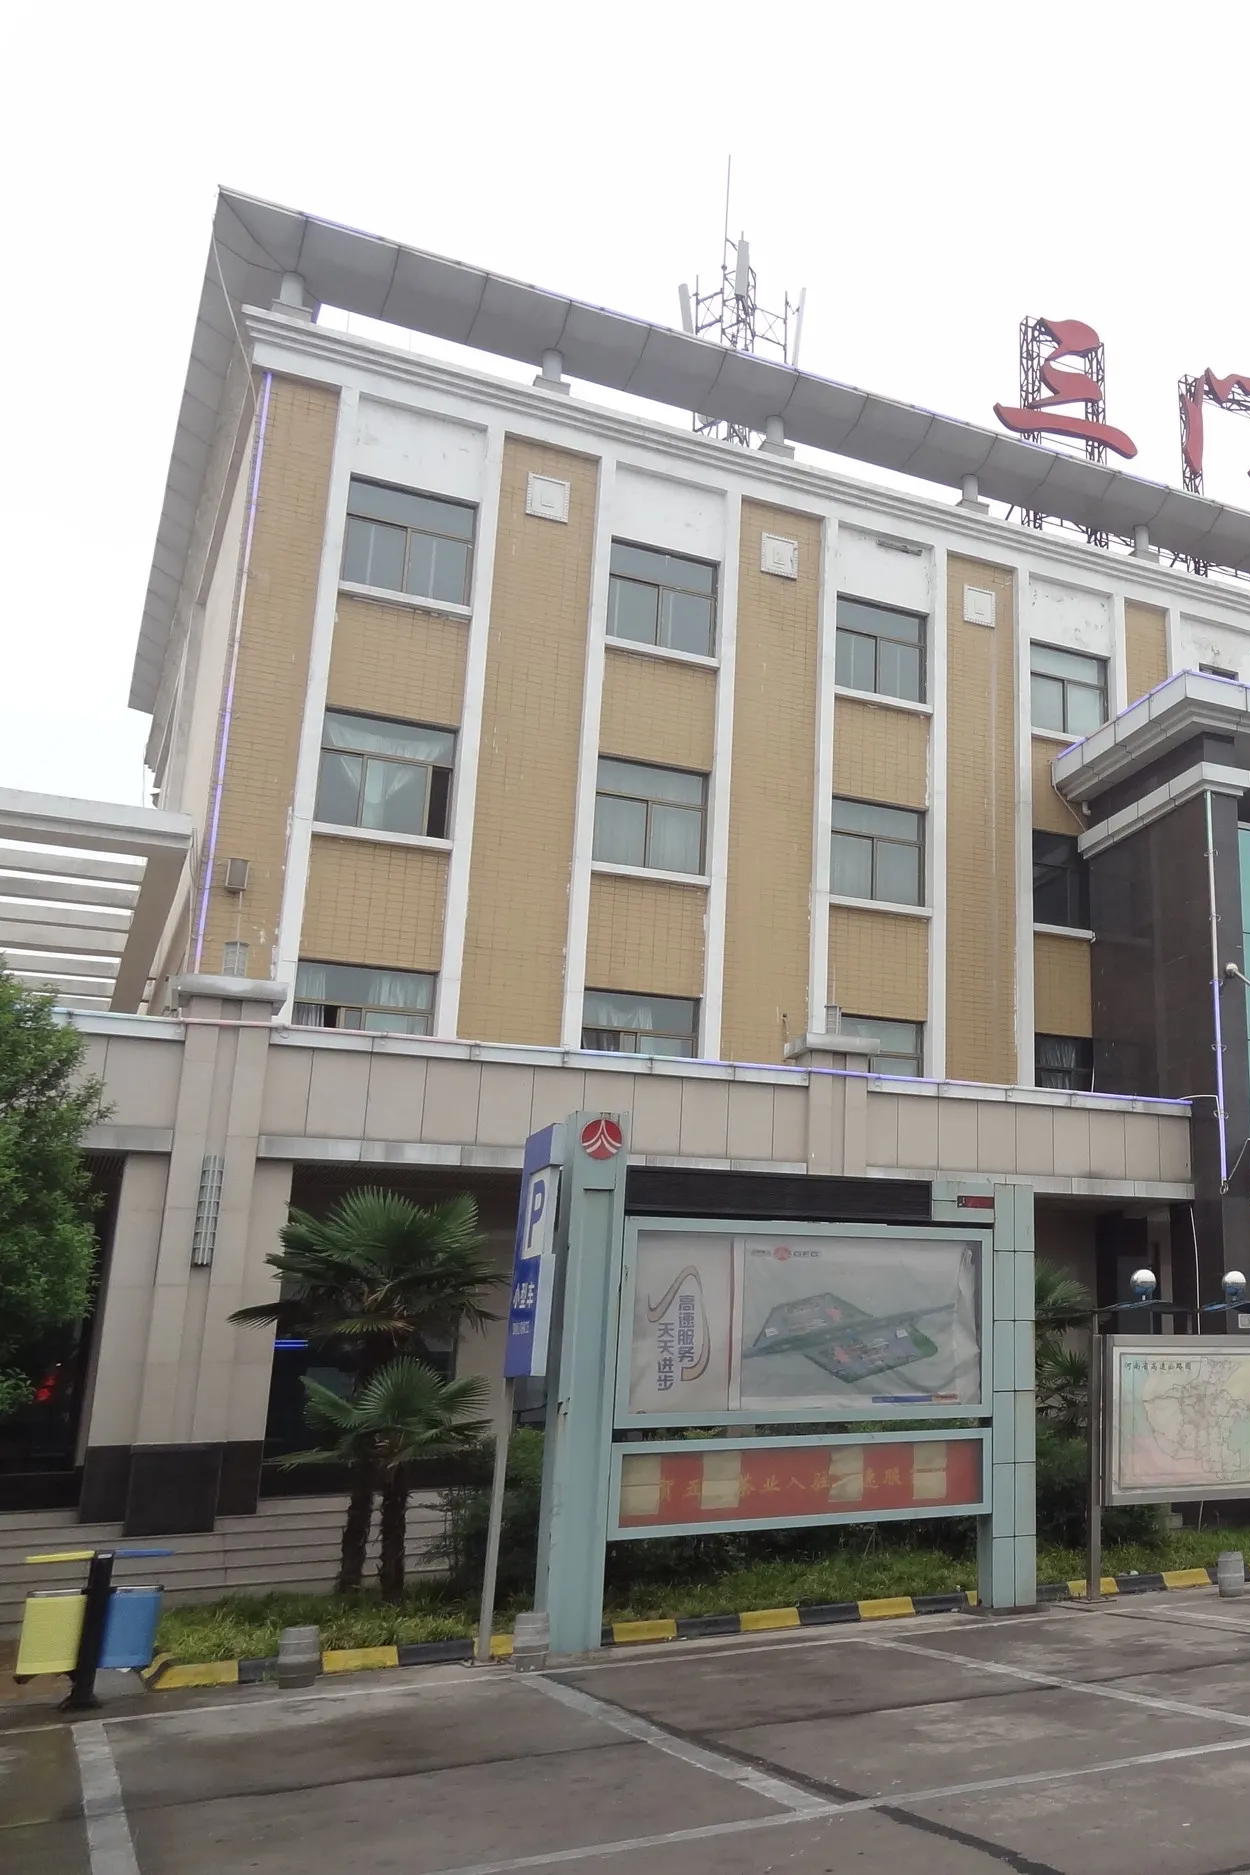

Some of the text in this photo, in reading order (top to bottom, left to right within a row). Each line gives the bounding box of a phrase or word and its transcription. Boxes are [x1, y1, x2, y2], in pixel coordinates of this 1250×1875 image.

[527, 1179, 546, 1249] P
[512, 1281, 536, 1309] 小型车
[677, 1294, 695, 1363] 高速服务
[657, 1322, 675, 1391] 天天进步
